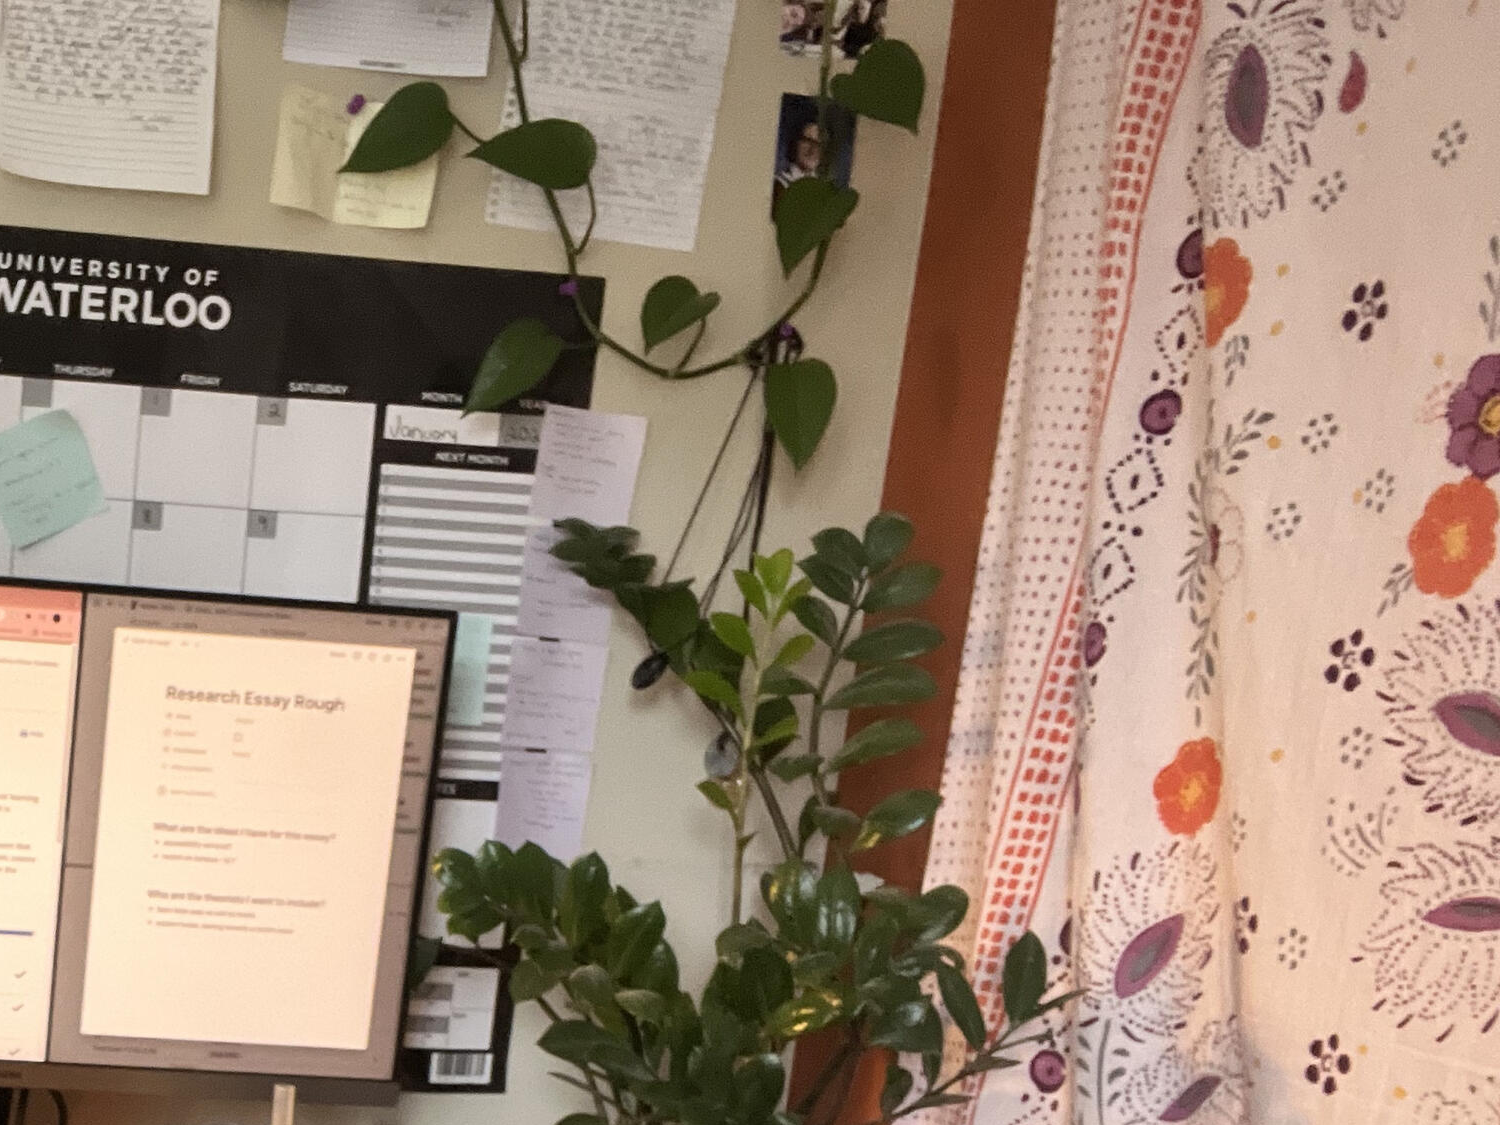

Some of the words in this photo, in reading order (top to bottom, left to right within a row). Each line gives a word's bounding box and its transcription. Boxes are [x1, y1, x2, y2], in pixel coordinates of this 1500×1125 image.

[183, 267, 221, 288] OF
[53, 364, 115, 378] THURSDAY
[180, 373, 222, 387] FRIDAY
[288, 382, 348, 396] SATURDAY
[389, 414, 458, 442] January
[436, 452, 466, 462] NEXT
[468, 454, 510, 466] MONTH
[165, 685, 241, 705] Research
[244, 691, 291, 711] Essay
[293, 694, 345, 714] Rough
